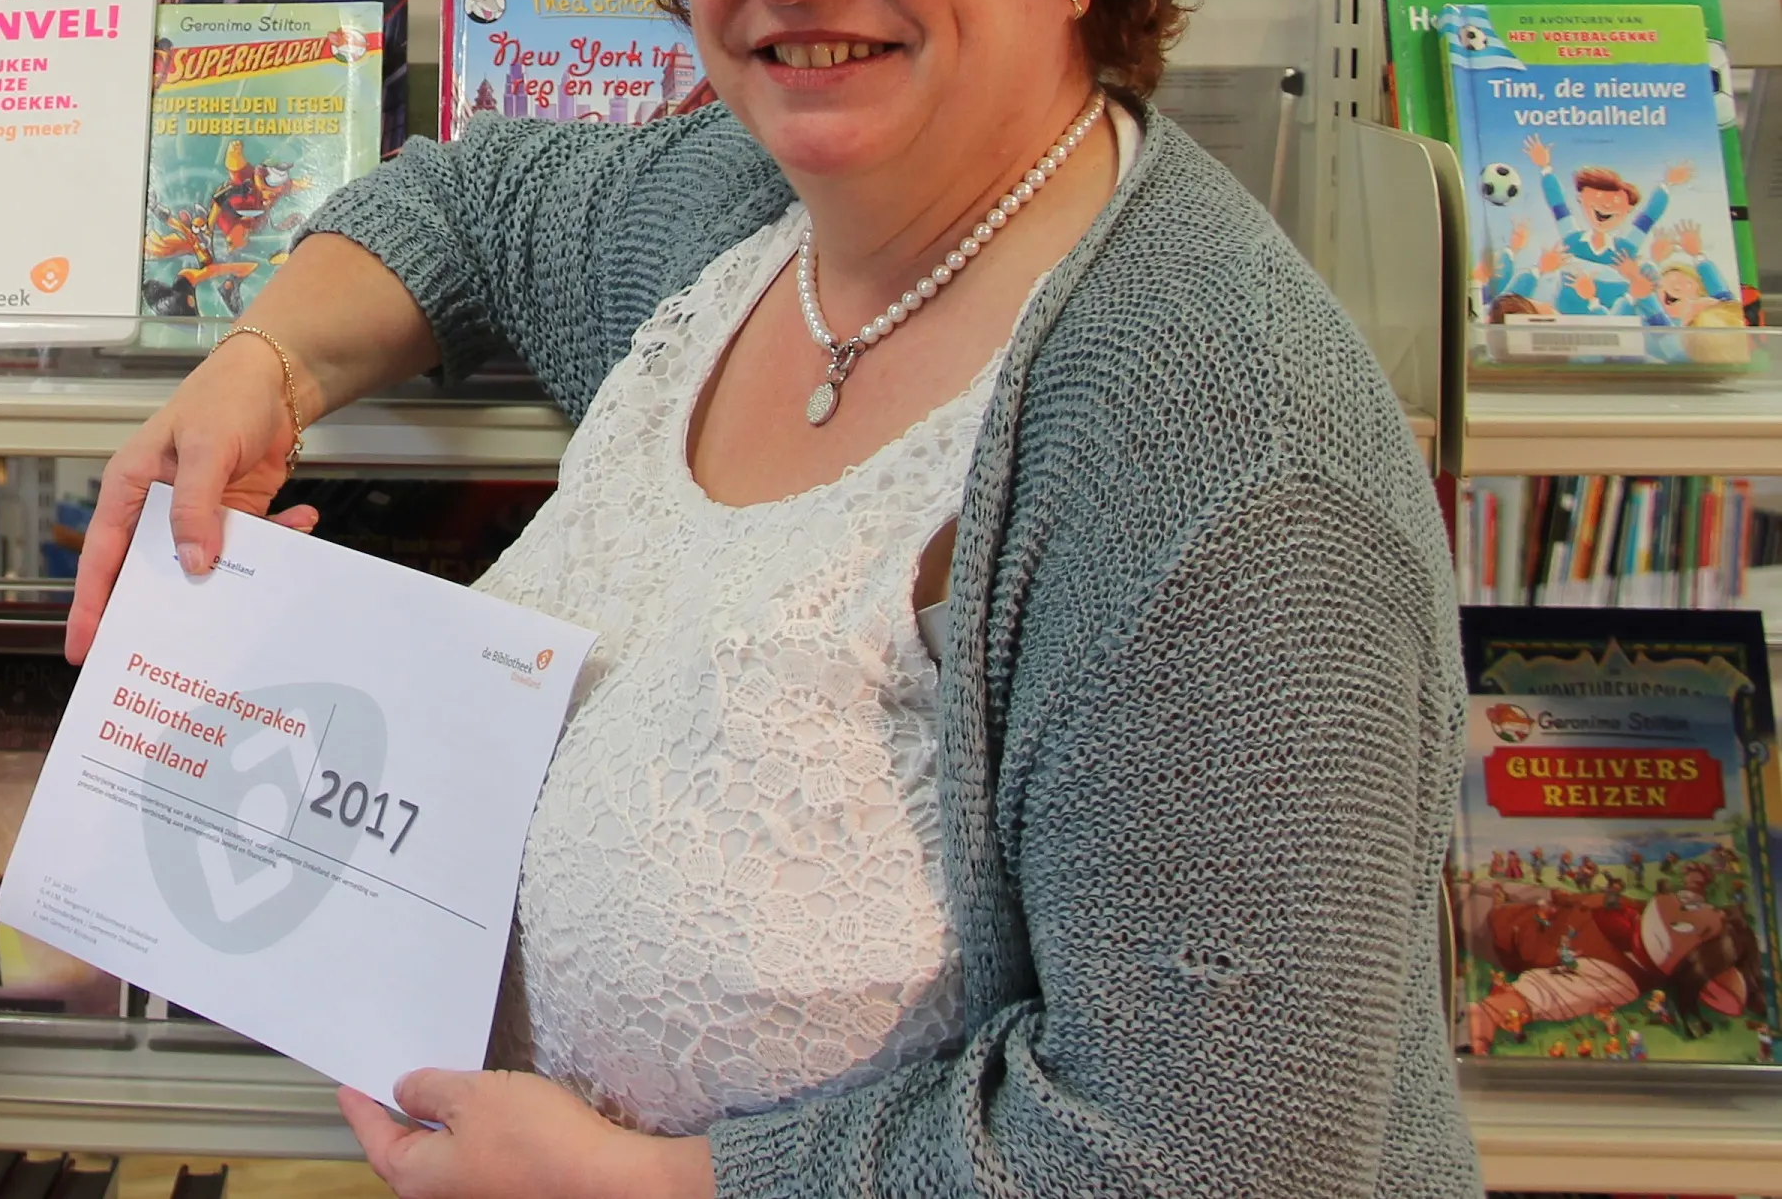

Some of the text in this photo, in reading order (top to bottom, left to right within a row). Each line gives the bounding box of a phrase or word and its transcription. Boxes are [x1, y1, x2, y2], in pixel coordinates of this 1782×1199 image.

[180, 16, 311, 32] Geronimo Stilton
[1539, 16, 1613, 25] AVONTUREN
[1616, 16, 1643, 24] VAN
[1508, 31, 1536, 42] HET
[167, 37, 327, 84] SUPERHELDEN
[488, 31, 675, 77] New York in
[1557, 47, 1612, 58] ELFTAL
[511, 79, 655, 108] rep en roer
[1487, 78, 1687, 101] Tim, de nieuwe
[153, 96, 345, 114] SUPERHELDEN TEGEN
[1514, 105, 1667, 126] voetbalheld
[22, 121, 81, 138] meer?
[154, 117, 340, 135] DE DUBBELGANGERS
[213, 555, 256, 576] Dinkelland
[492, 650, 533, 675] Bibliotheek
[126, 652, 307, 738] Prestatieafspraken
[112, 686, 228, 748] Bibliotheek
[1537, 711, 1621, 730] Geronimo
[98, 720, 210, 779] Dinkelland
[1506, 756, 1699, 781] GULLIVERS
[1542, 784, 1666, 807] REIZEN
[309, 769, 420, 854] 2017
